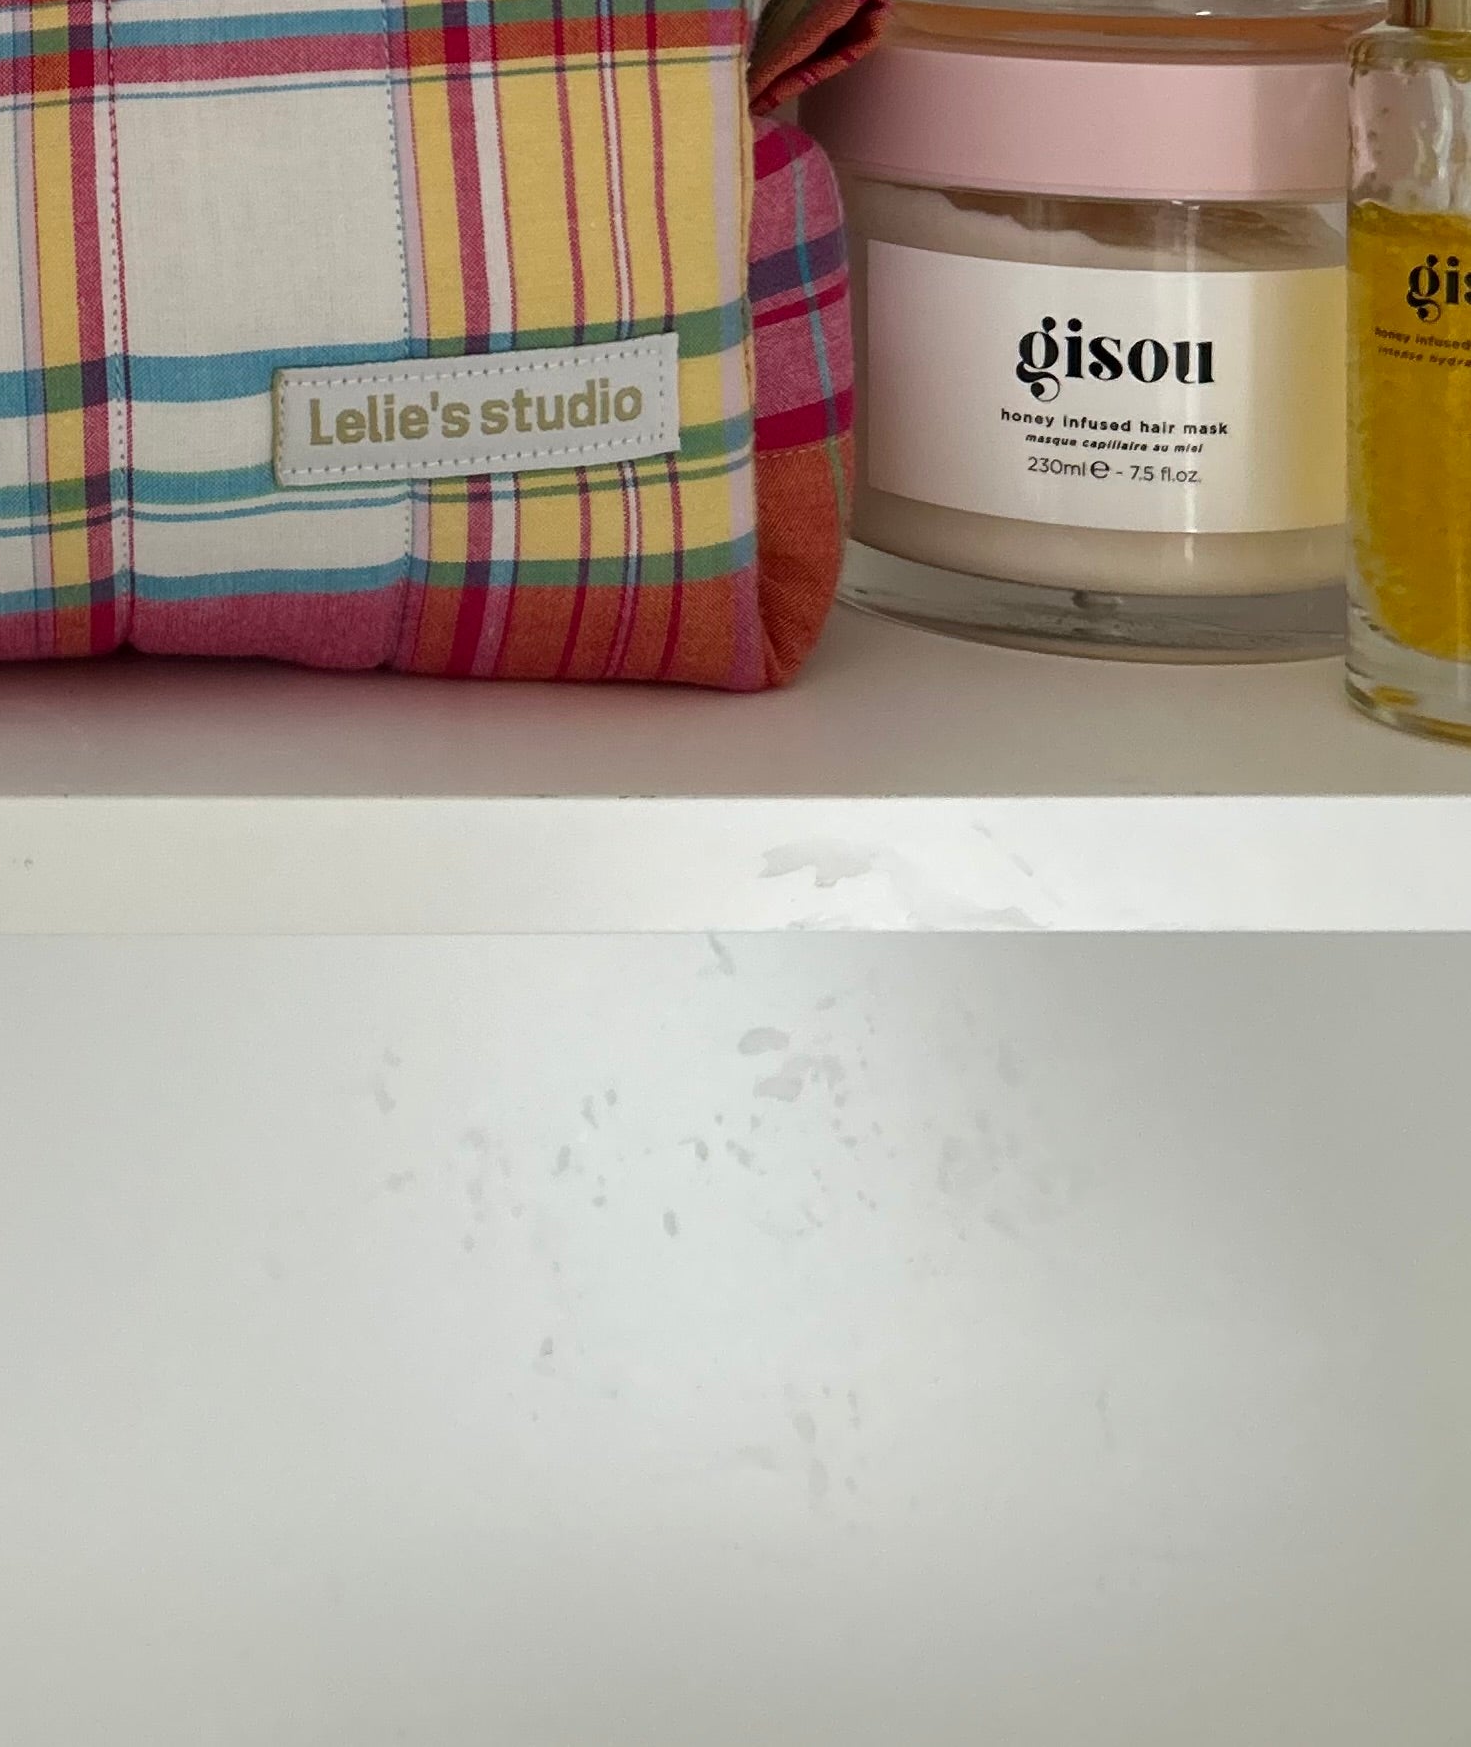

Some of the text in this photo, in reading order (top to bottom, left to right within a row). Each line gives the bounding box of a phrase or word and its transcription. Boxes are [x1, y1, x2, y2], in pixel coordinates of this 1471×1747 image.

[1015, 316, 1215, 402] gisou
[309, 377, 643, 446] Lelie's studio
[1000, 408, 1228, 435] honey infused hair mask
[1025, 433, 1203, 453] masque capillaire au miel
[1027, 456, 1086, 477] 230ml
[1130, 465, 1154, 481] 7.5
